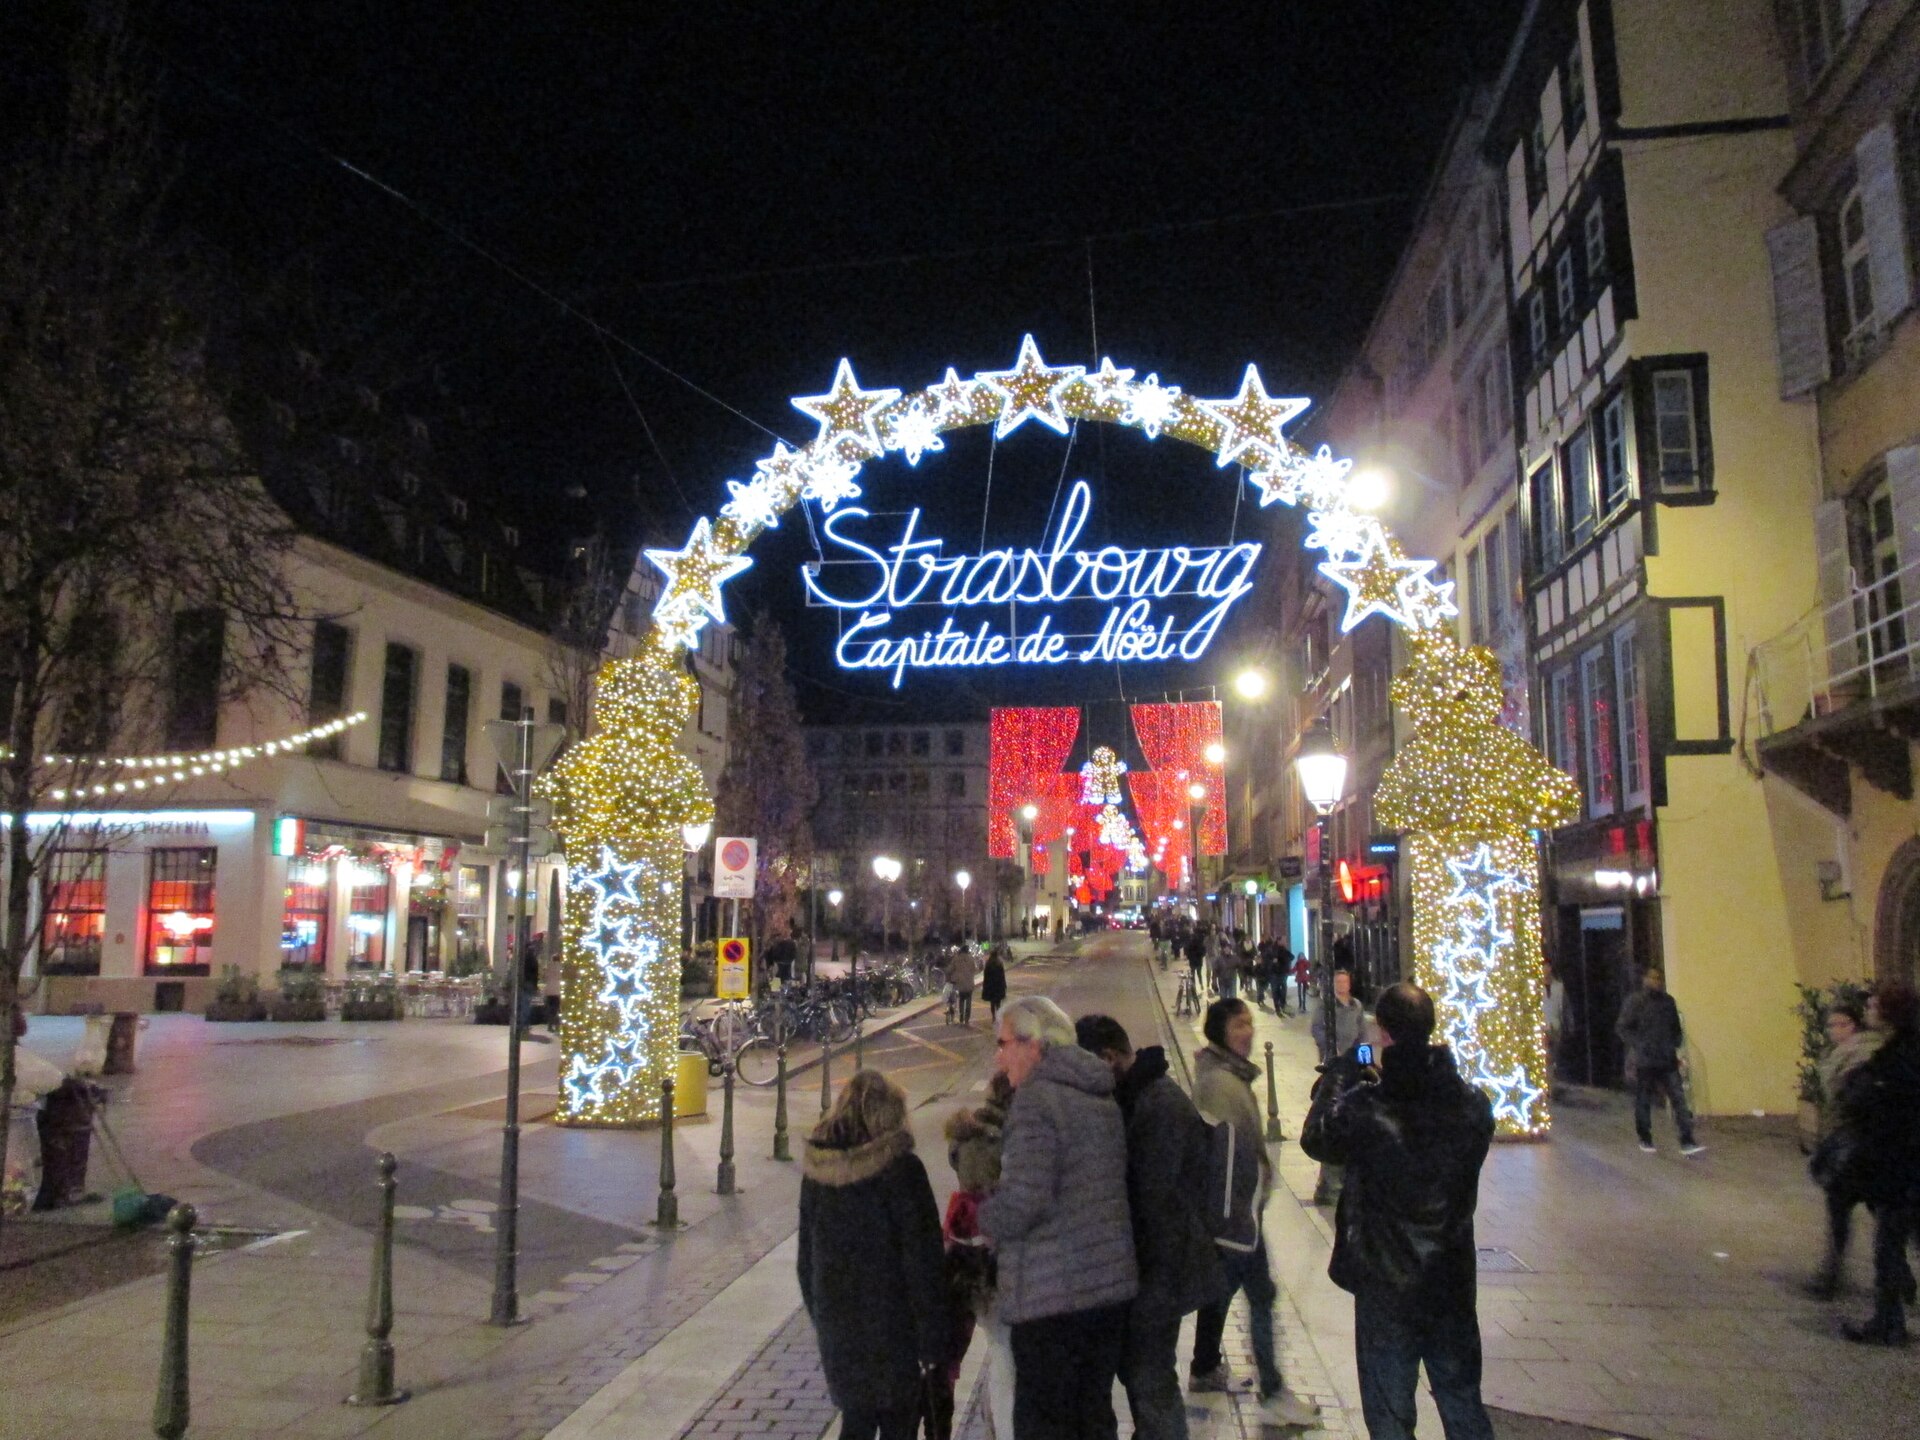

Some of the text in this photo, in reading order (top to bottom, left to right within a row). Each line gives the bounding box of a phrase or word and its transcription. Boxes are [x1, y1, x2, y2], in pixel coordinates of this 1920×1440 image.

[801, 480, 1262, 661] Strasbourg
[836, 598, 1175, 688] Capitale de Noël
